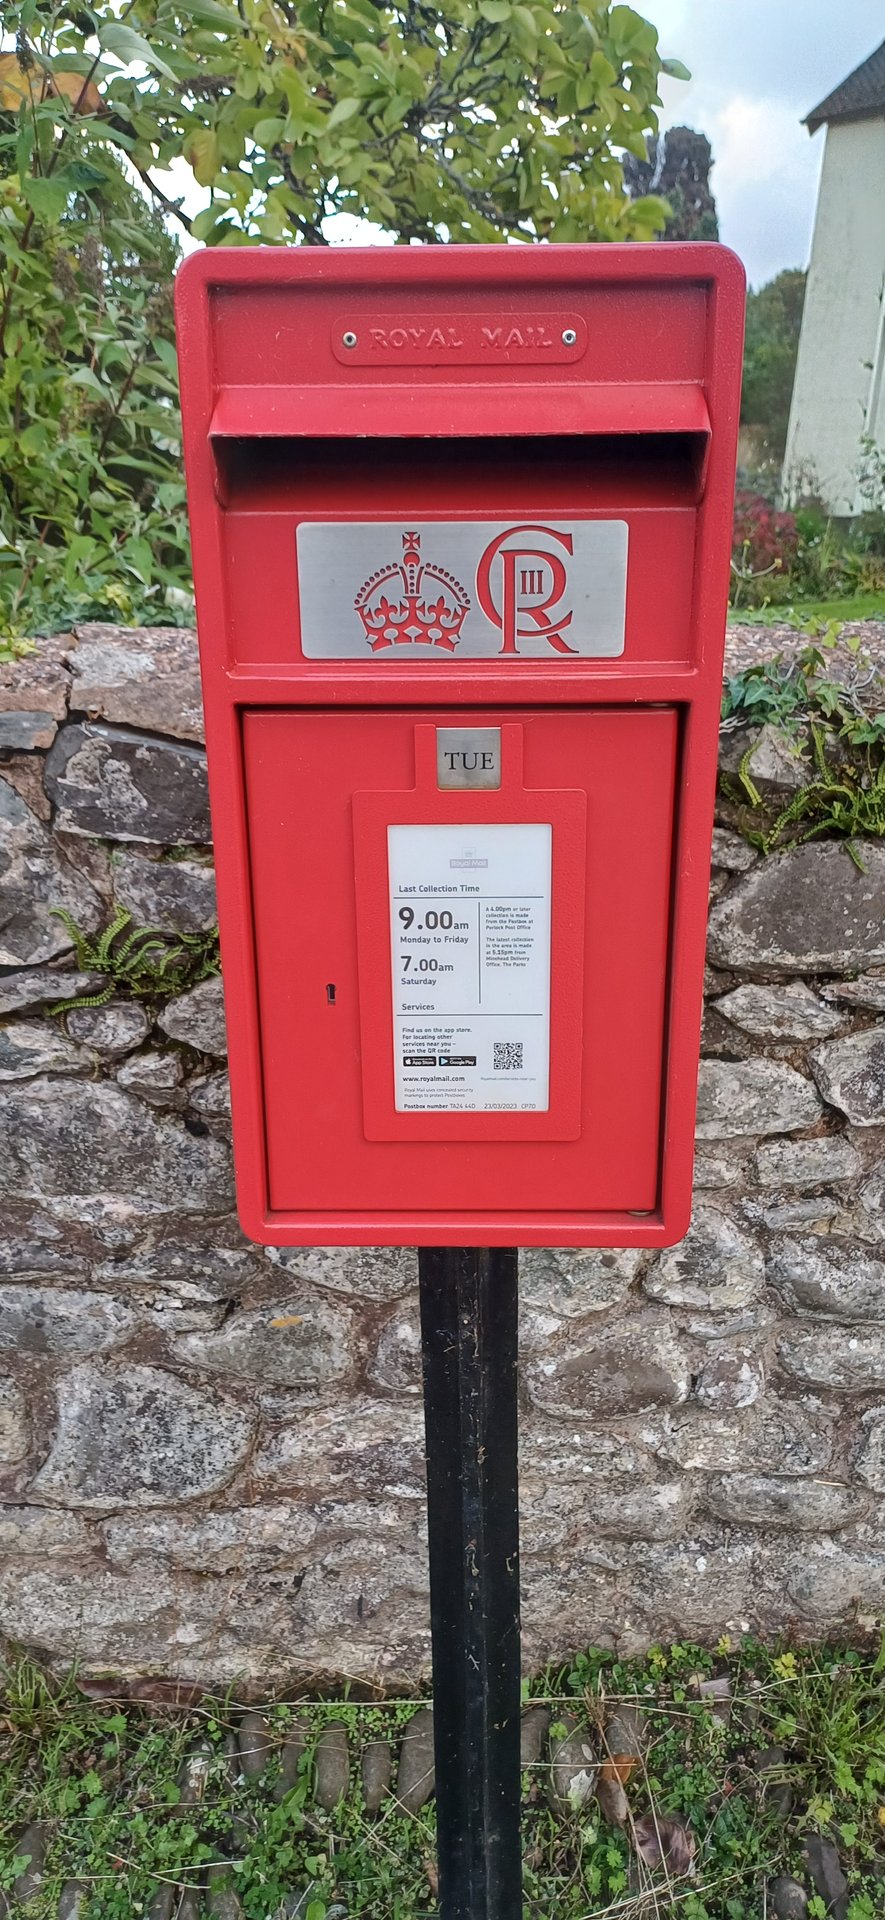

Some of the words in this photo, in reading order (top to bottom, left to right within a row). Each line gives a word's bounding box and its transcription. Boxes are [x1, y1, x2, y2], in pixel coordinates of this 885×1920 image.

[369, 328, 464, 350] ROYAL
[480, 327, 553, 349] MAIL
[520, 570, 544, 595] III
[444, 752, 495, 771] TUE
[451, 860, 471, 868] Royal
[398, 885, 416, 893] Last
[419, 885, 457, 893] Collection
[400, 936, 431, 944] Monday
[444, 936, 469, 944] Friday
[400, 956, 454, 972] 7.00am
[401, 978, 437, 986] Saturday
